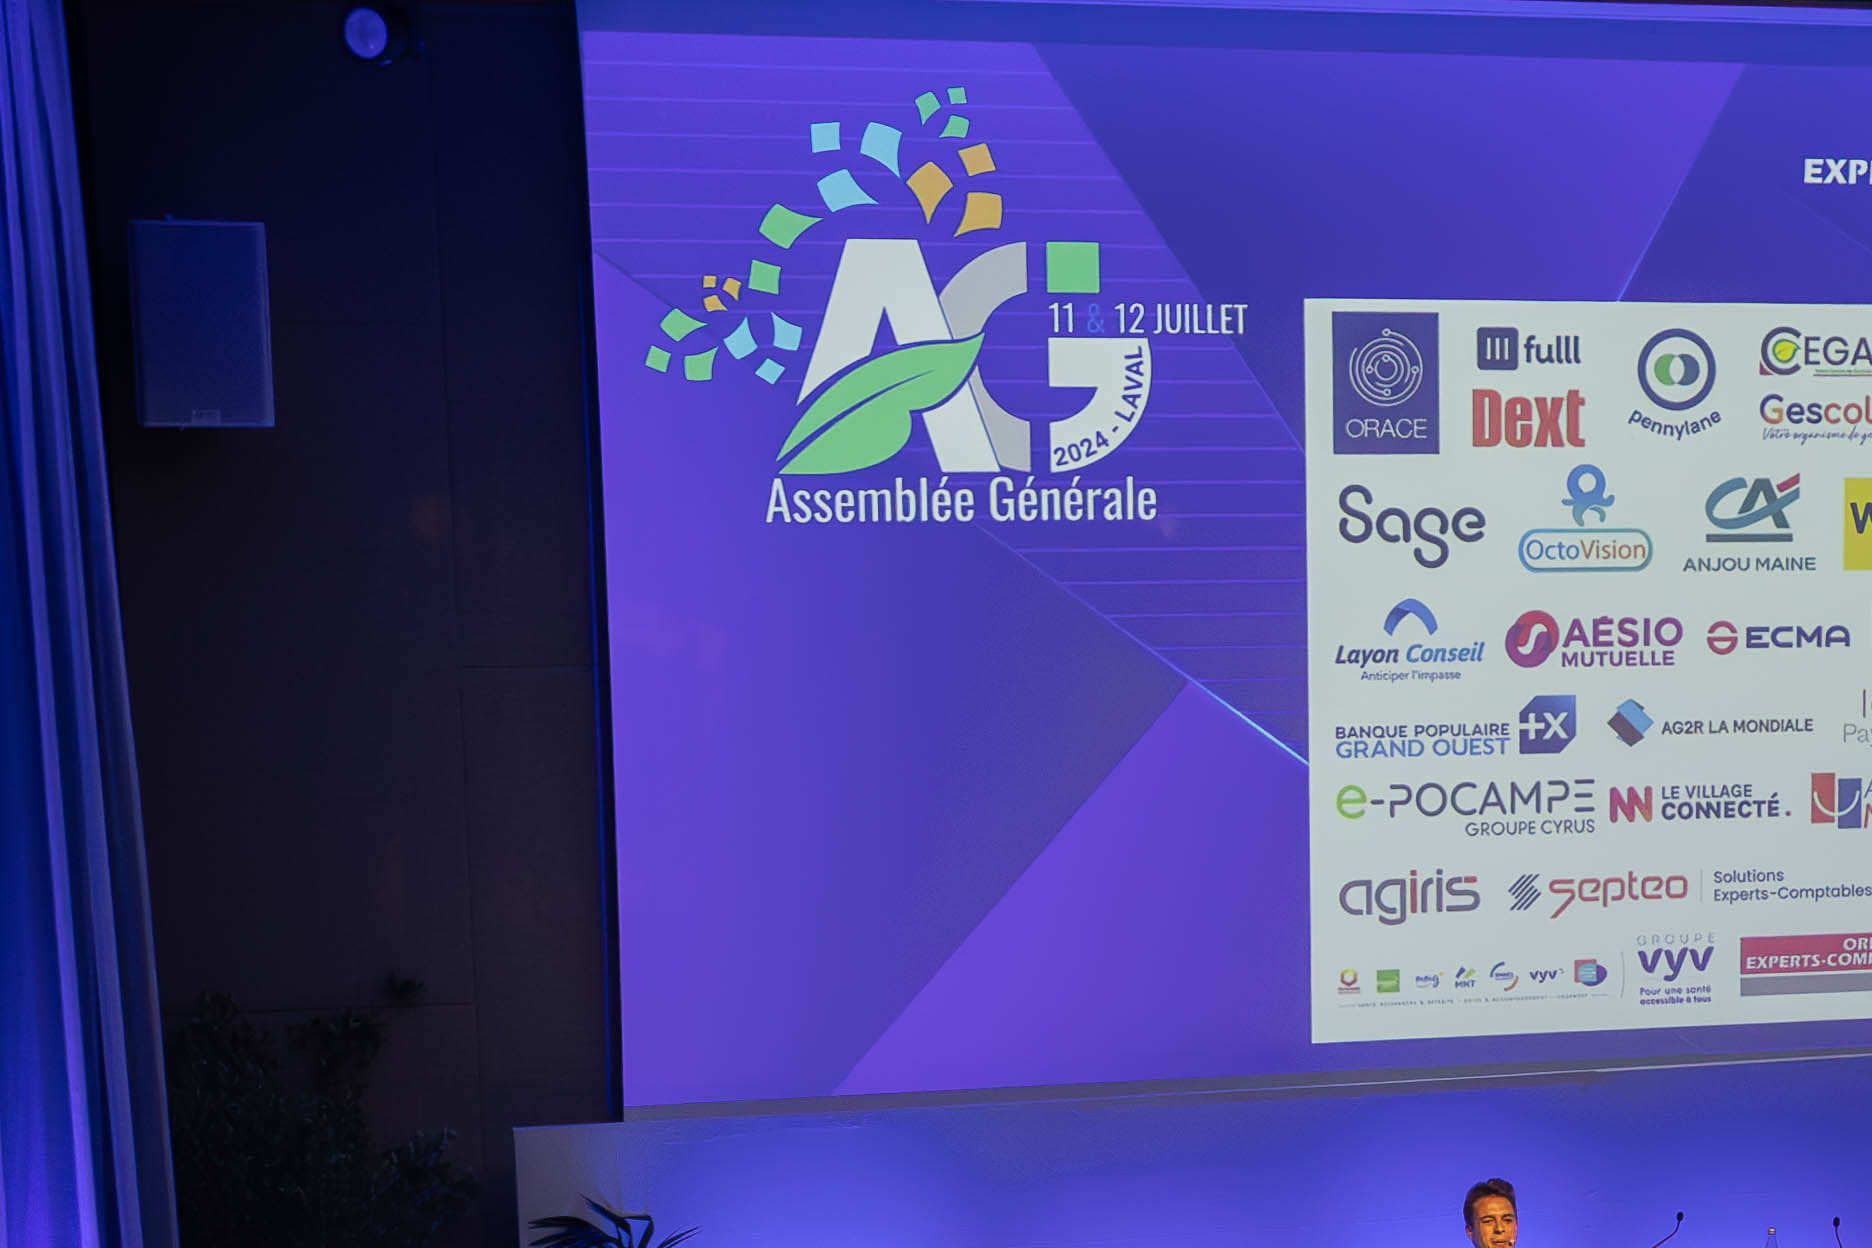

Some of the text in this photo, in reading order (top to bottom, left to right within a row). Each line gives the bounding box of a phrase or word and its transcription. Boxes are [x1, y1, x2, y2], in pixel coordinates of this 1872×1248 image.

[1048, 303, 1248, 335] 11 & 12 JUILLET
[1524, 335, 1581, 365] fulll
[1053, 431, 1109, 467] 2024
[1115, 345, 1144, 422] LAVAL
[1346, 419, 1428, 440] ORACE
[1472, 389, 1586, 448] Dext
[1628, 408, 1722, 441] pennylane
[765, 475, 1157, 524] Assemblée Générale
[1339, 484, 1486, 569] Sage
[1526, 539, 1646, 562] OctoVision
[1683, 556, 1817, 573] ANJOU MAINE
[1562, 615, 1683, 648] AÉSIO
[1746, 624, 1850, 649] ECMA
[1335, 641, 1485, 669] Layon Conseil
[1561, 650, 1675, 667] MUTUELLE
[1361, 670, 1409, 684] Anticiper
[1335, 723, 1510, 740] BANQUE POPULAIRE
[1661, 718, 1814, 735] AG2R LA MONDIALE
[1336, 737, 1510, 758] GRAND OUEST
[1336, 779, 1596, 819] e-POCAMPE
[1661, 784, 1753, 800] LE VILLAGE
[1465, 819, 1595, 837] GROUPE CYRUS
[1713, 869, 1784, 884] Solutions
[1339, 868, 1481, 926] agiris
[1549, 870, 1688, 919] septeo
[1713, 884, 1872, 904] Experts-Comptables
[1636, 932, 1716, 946] GROUPE
[1637, 946, 1714, 982] vyv
[1640, 987, 1661, 997] Pour
